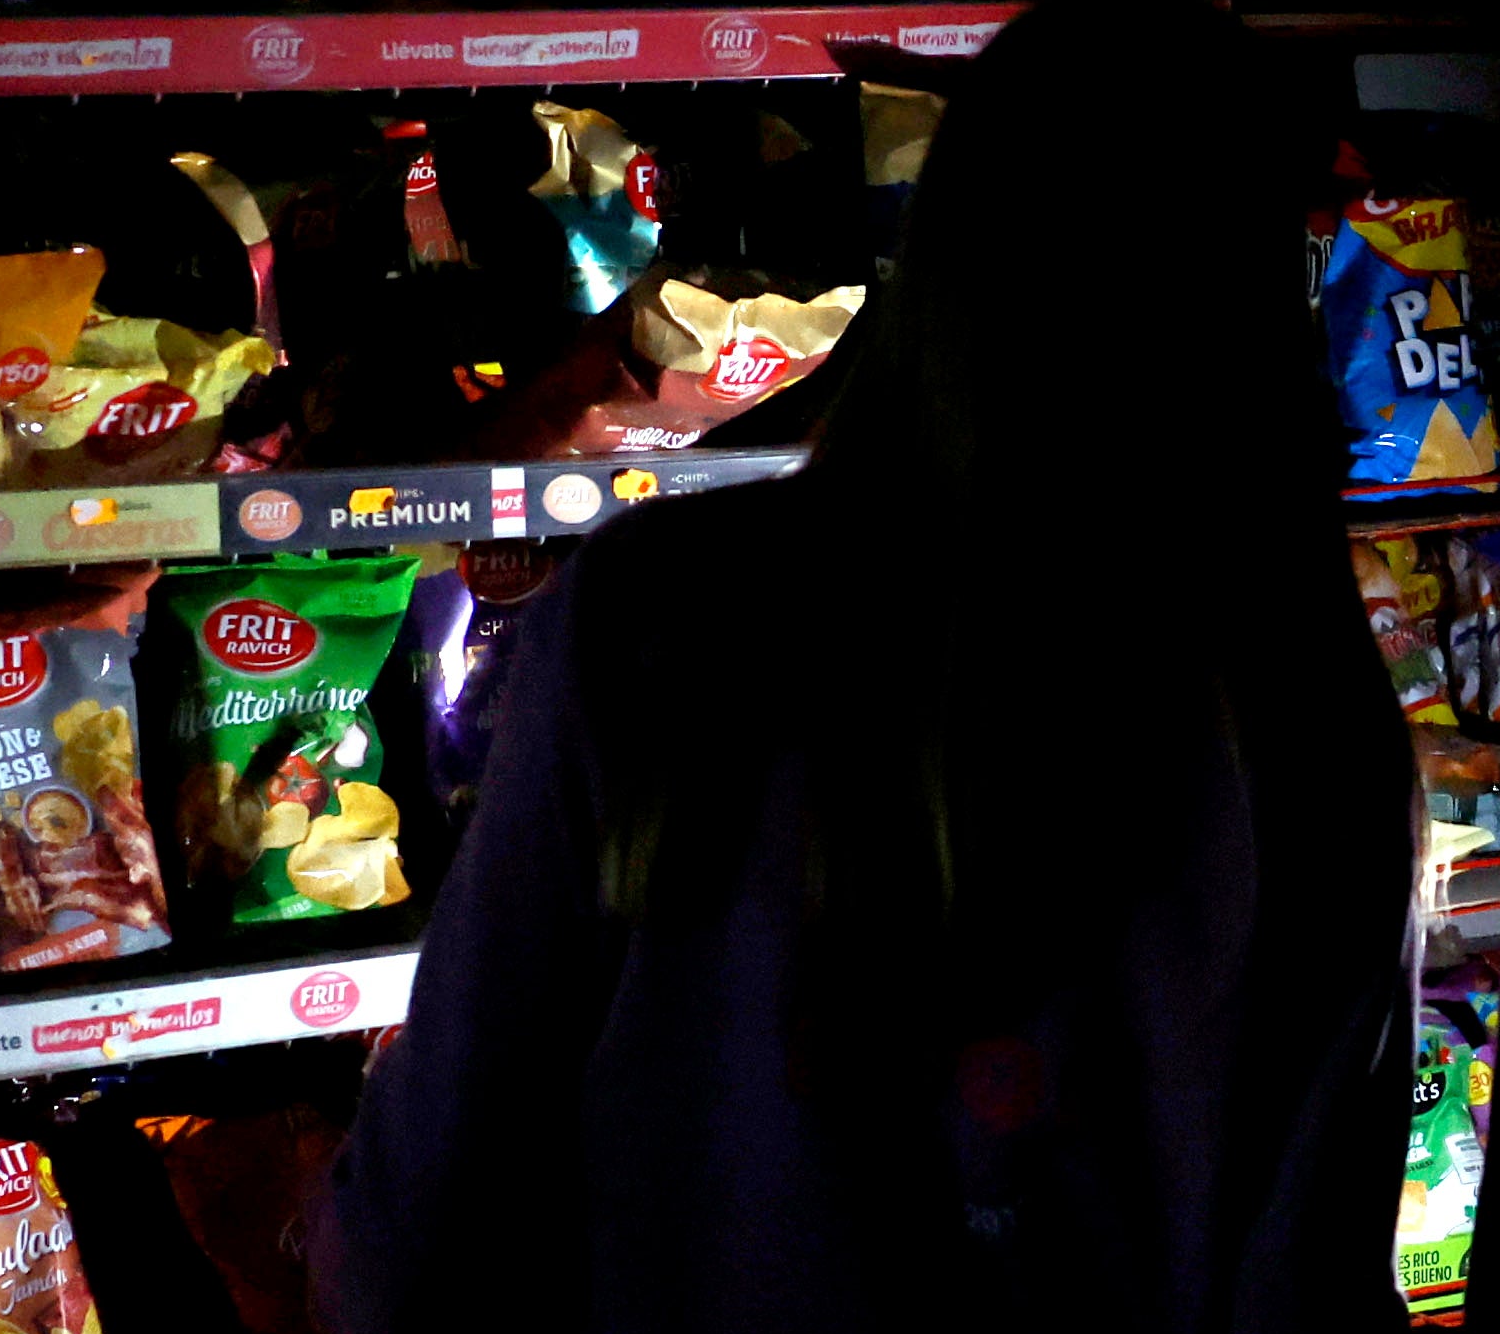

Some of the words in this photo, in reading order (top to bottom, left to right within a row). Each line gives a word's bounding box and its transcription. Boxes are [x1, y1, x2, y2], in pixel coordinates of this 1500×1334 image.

[710, 29, 758, 50] FRIT
[903, 27, 956, 46] buenos
[251, 38, 303, 58] FRIT
[382, 41, 455, 61] Llévate
[716, 354, 785, 385] FRIT
[98, 400, 191, 436] FRIT
[553, 487, 596, 505] FRIT
[248, 502, 291, 522] FRIT
[330, 501, 471, 528] PREMIUM
[217, 613, 301, 642] FRIT
[226, 641, 292, 656] RAVICH
[299, 982, 348, 1006] FRIT
[36, 1021, 105, 1047] buenos
[1412, 1250, 1439, 1268] RICO
[1412, 1265, 1452, 1286] BUENO
